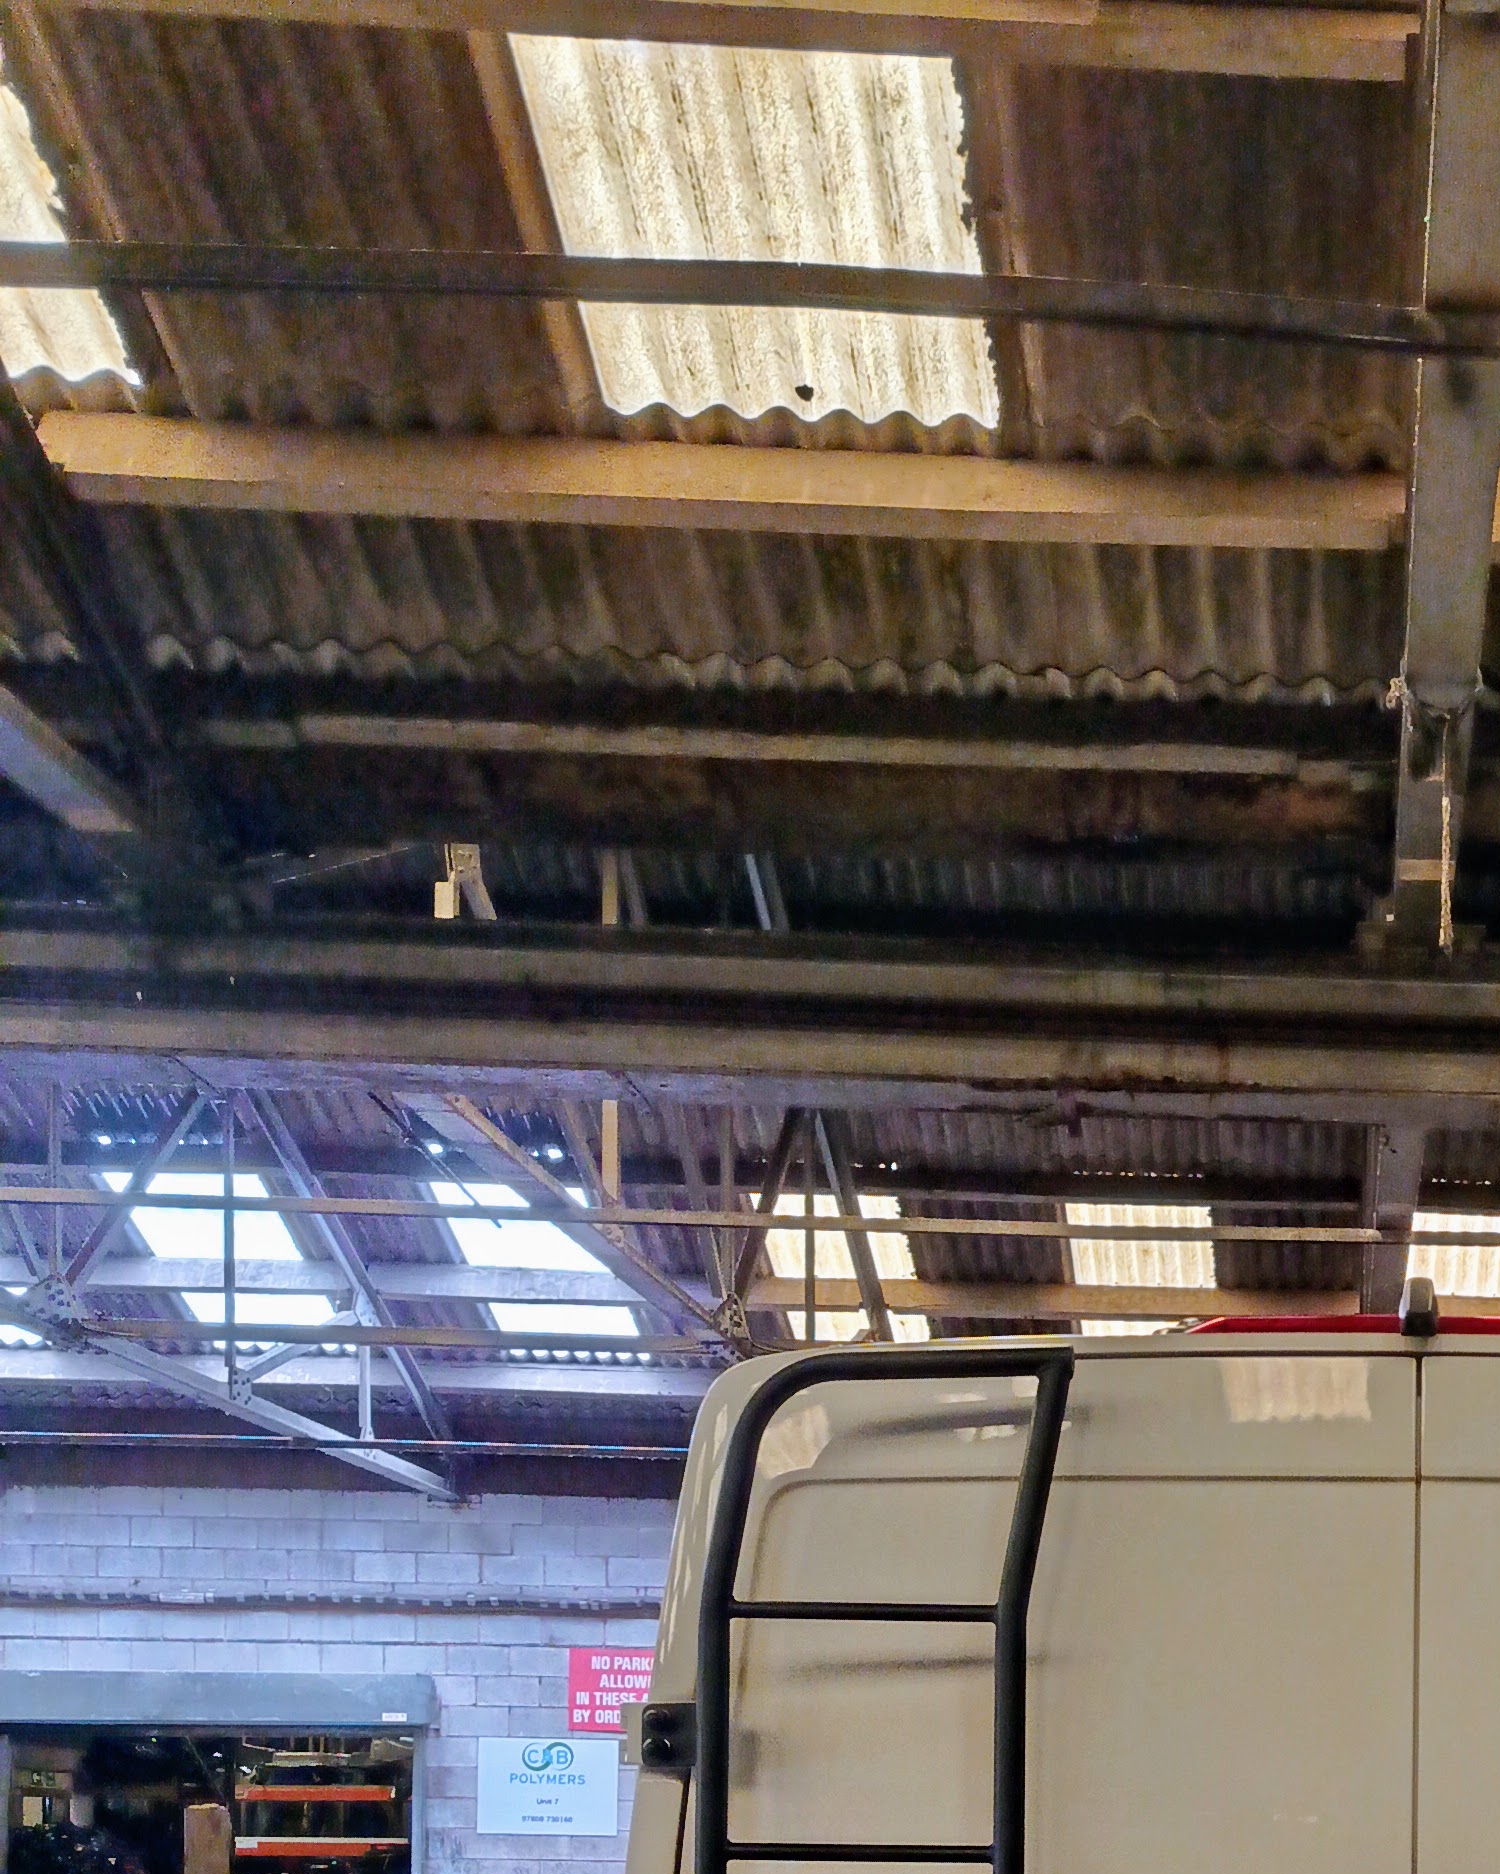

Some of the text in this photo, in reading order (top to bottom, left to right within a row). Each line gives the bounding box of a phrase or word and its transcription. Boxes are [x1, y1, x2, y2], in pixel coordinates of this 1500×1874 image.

[591, 1656, 611, 1670] NO
[576, 1691, 590, 1705] IN
[593, 1691, 637, 1706] THESE
[573, 1709, 621, 1724] BY ORD
[509, 1772, 586, 1785] POLYMERS
